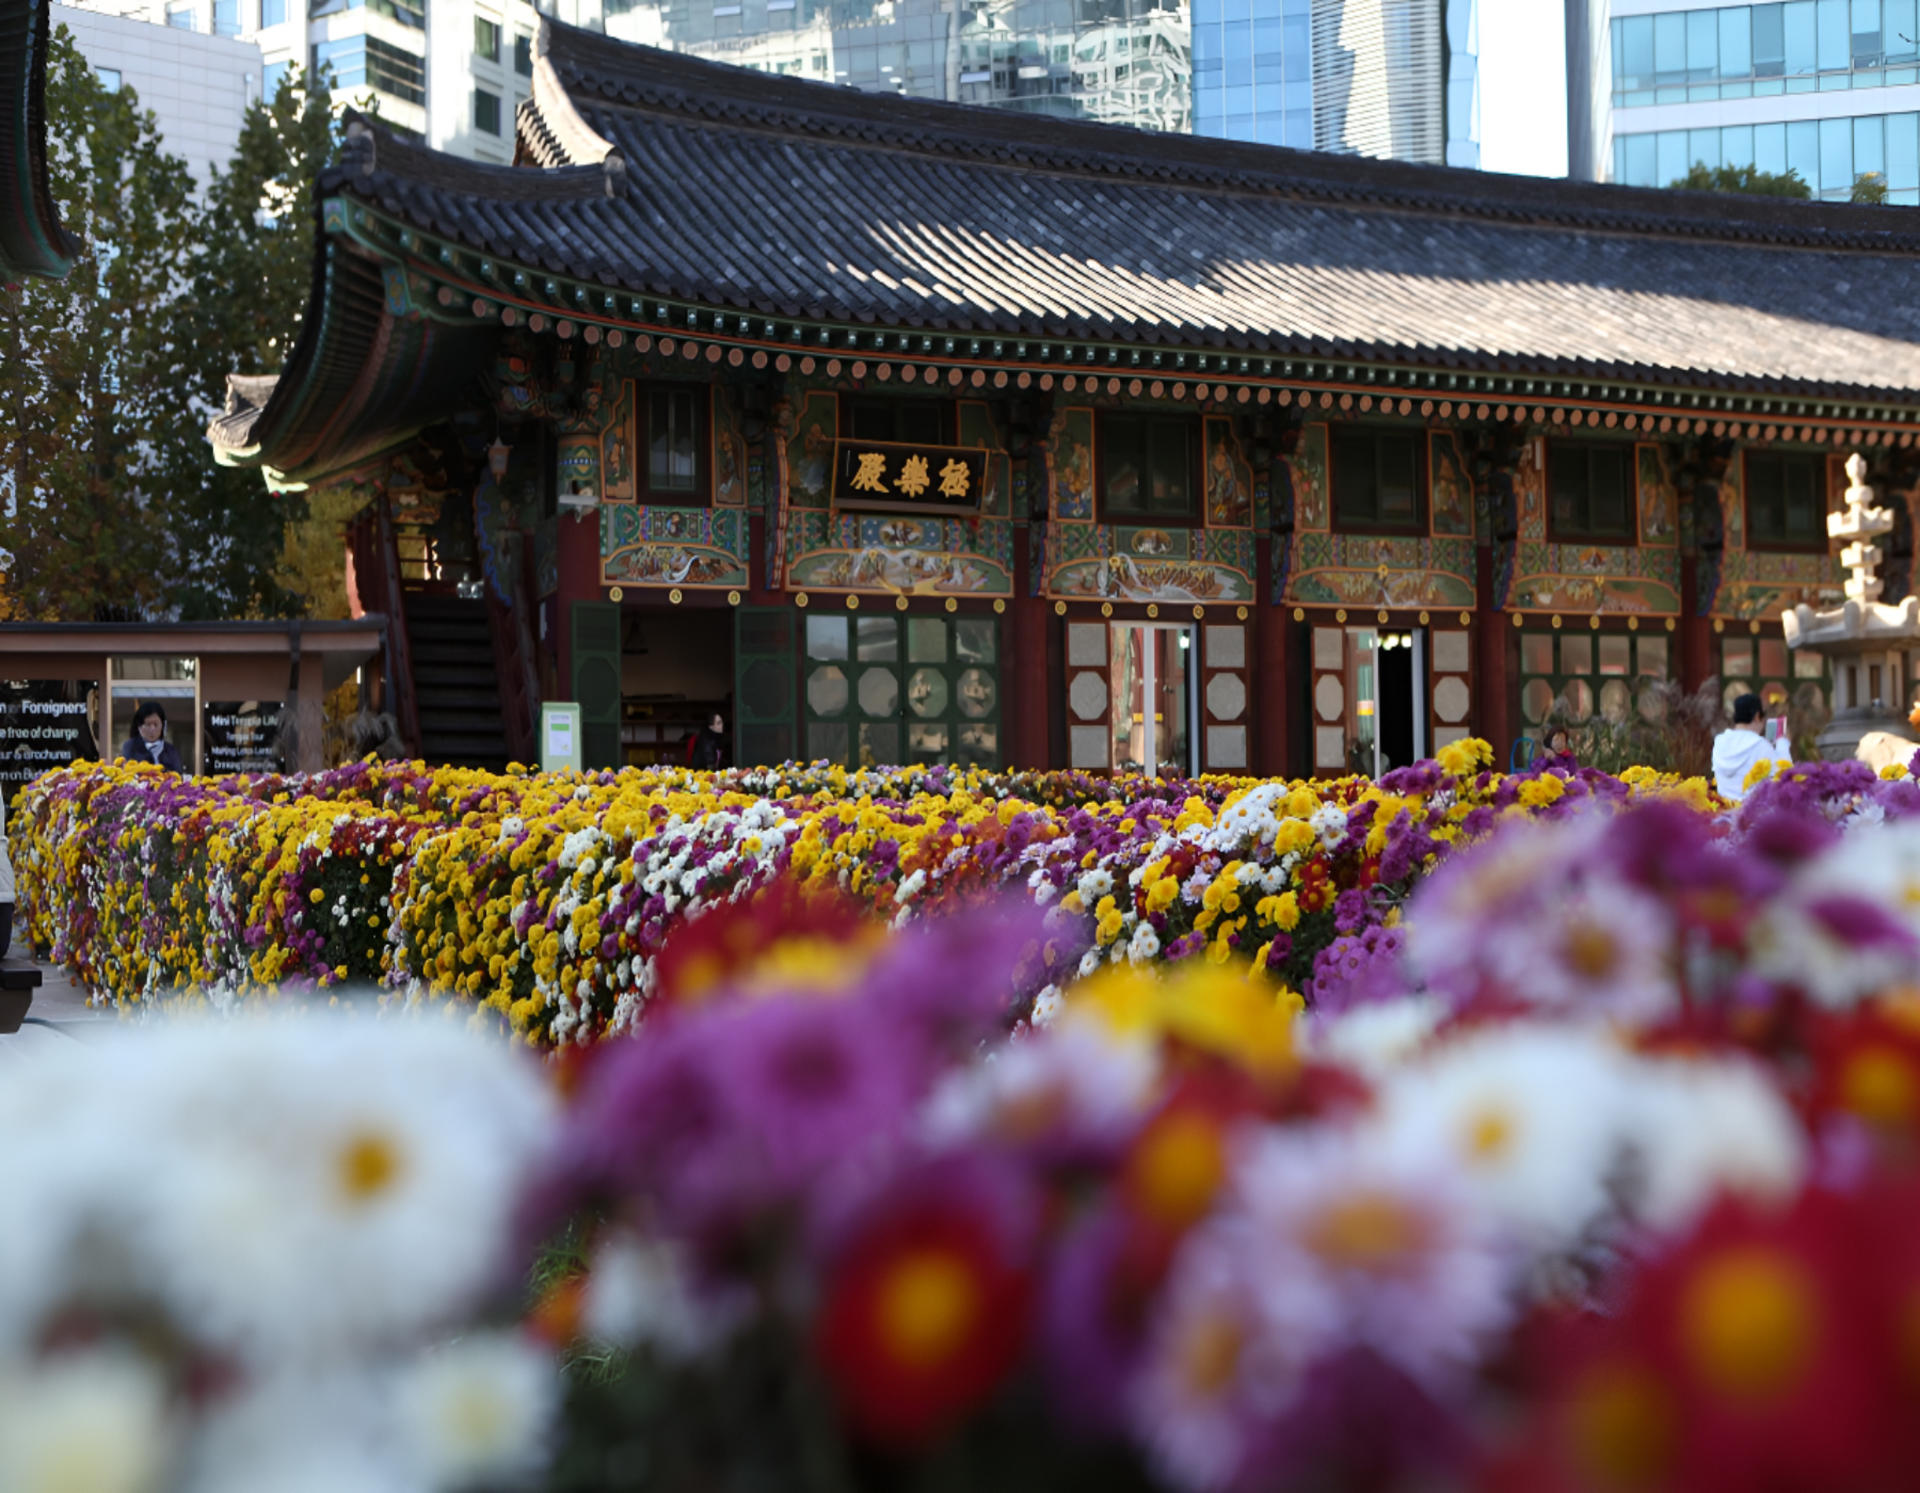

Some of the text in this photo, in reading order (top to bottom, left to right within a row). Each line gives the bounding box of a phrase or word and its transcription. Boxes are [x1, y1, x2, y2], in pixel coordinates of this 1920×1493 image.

[21, 699, 87, 717] Foreigners
[211, 714, 230, 727] Mini
[7, 726, 29, 739] free
[30, 726, 41, 739] of
[42, 726, 79, 742] charge
